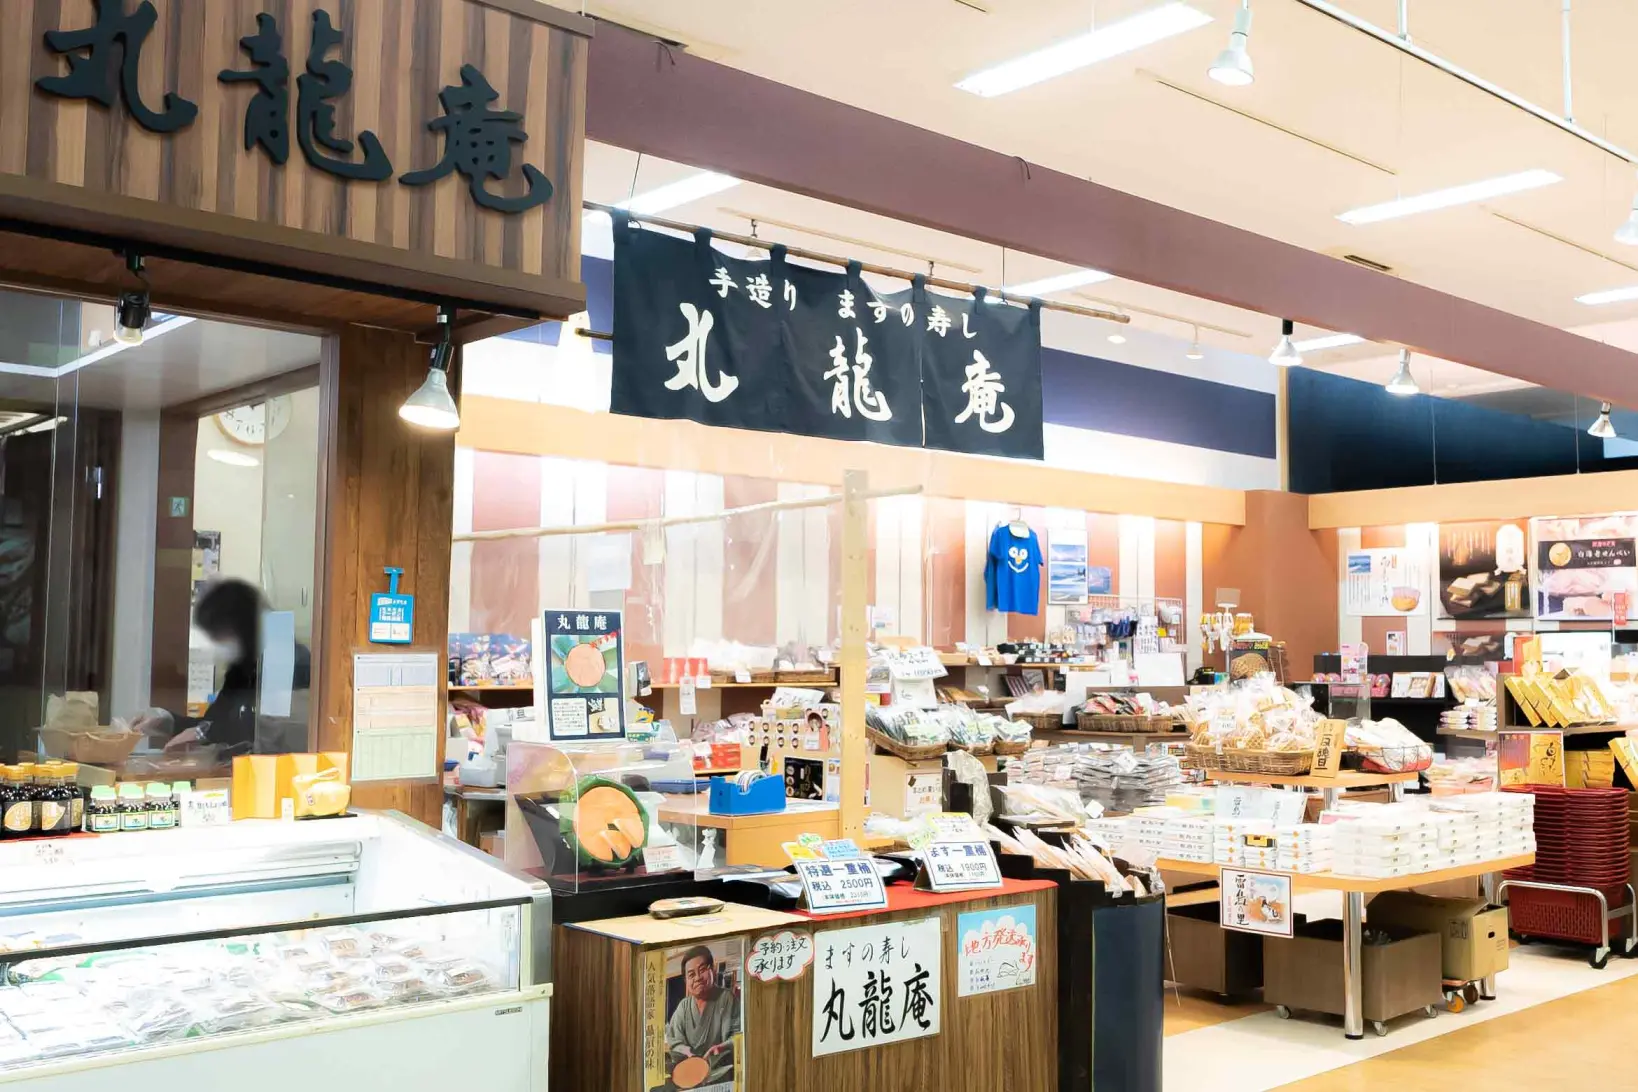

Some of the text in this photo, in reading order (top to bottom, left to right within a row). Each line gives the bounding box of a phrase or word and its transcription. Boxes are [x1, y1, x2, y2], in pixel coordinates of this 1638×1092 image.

[35, 0, 553, 213] 丸龍庵
[708, 267, 978, 339] 手造り ますの寿し
[664, 302, 1016, 434] 丸龍庵
[557, 614, 608, 630] 丸龍庵
[930, 844, 987, 858] ます一重桶
[805, 862, 872, 877] 特選一重桶
[961, 862, 987, 872] 1900円
[811, 878, 873, 891] 税込 2500円
[825, 935, 910, 970] ますの寿し
[754, 954, 795, 974] 承ります
[819, 963, 935, 1044] 丸龍庵
